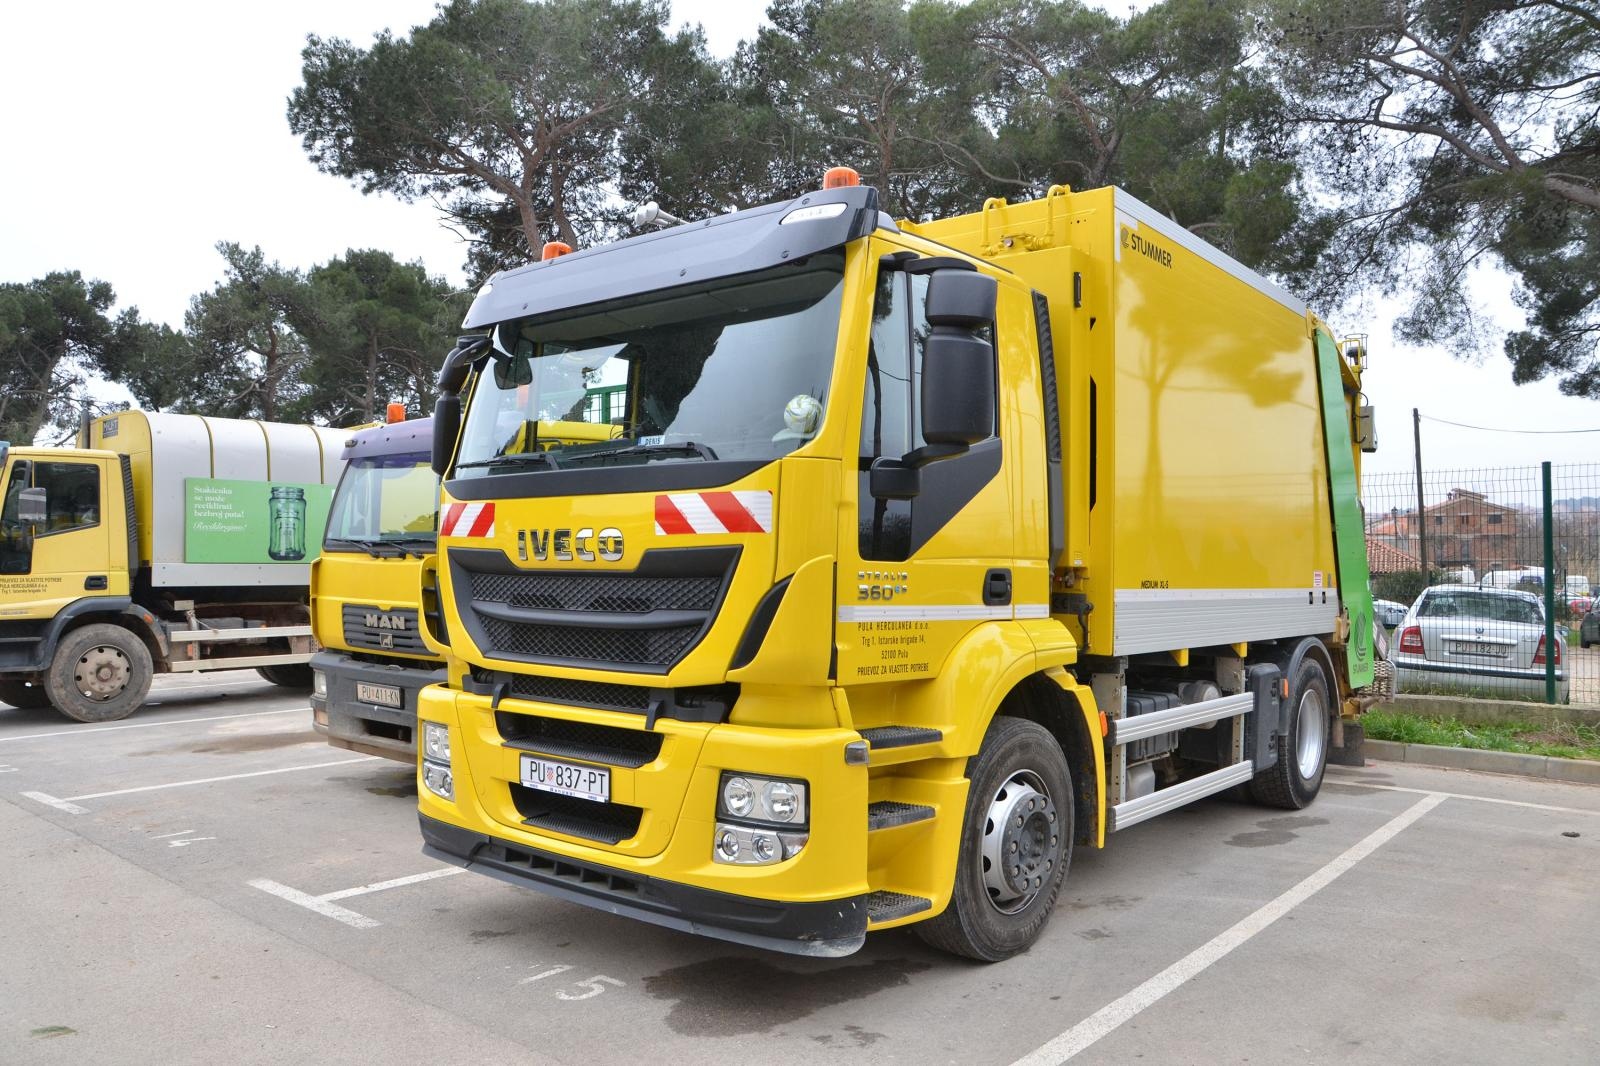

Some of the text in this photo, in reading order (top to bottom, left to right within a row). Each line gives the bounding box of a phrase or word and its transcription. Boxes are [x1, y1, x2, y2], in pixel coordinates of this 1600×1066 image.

[1131, 233, 1172, 269] STUMMER
[517, 527, 625, 561] IVECO
[858, 571, 908, 581] STRALIS
[857, 584, 894, 601] 360
[365, 613, 405, 630] MAN
[858, 621, 874, 631] PULA
[876, 620, 912, 631] HERCULANEA
[862, 635, 871, 647] Trg
[878, 635, 899, 646] Istarske
[900, 634, 918, 646] brigade
[1455, 642, 1468, 652] PU
[881, 649, 909, 660] 52100 Pula
[857, 662, 929, 677] PRIJEVOZ ZA VLASTITE POTREBE
[362, 686, 371, 699] PU
[529, 760, 606, 795] PU 837-PT
